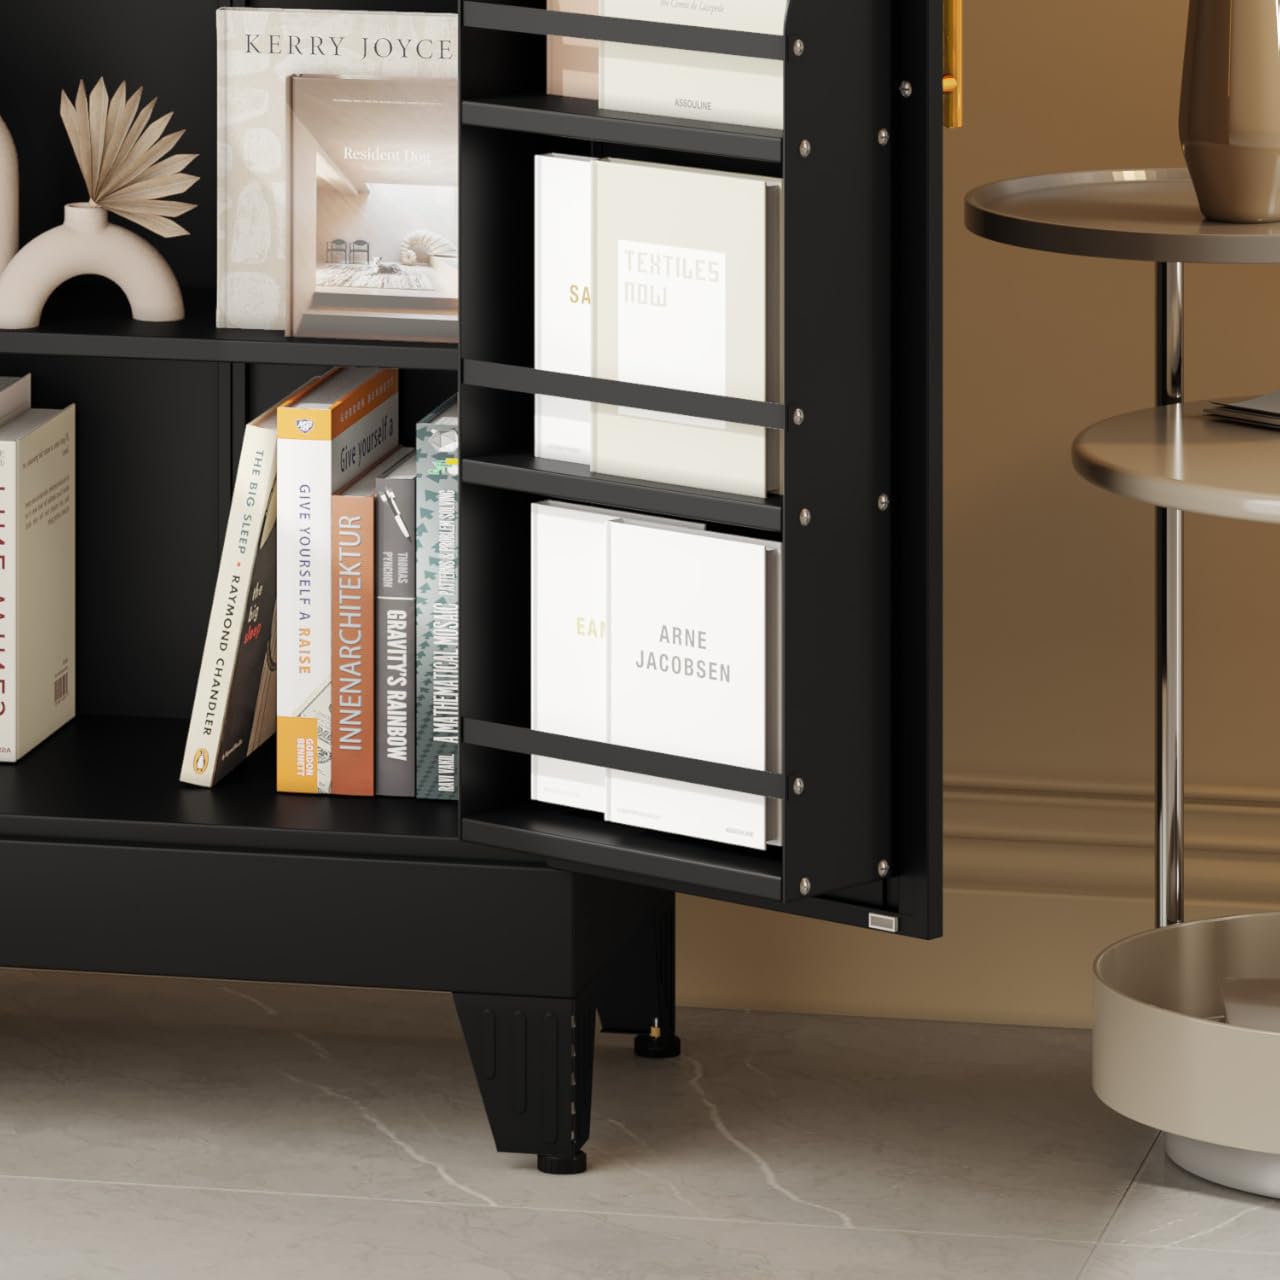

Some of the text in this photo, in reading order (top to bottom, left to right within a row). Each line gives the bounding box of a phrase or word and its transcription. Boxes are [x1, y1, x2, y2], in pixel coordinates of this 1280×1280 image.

[244, 33, 454, 62] KERRY JOYCE
[674, 97, 713, 111] ASSOULINE
[343, 146, 432, 166] Resident Dog
[623, 249, 720, 284] TEXTILES
[569, 284, 591, 305] SA
[340, 415, 394, 473] Give yourself a
[237, 449, 265, 556] THE BIG SLEEP
[298, 483, 311, 676] GIVE YOURSELF A RAISE
[382, 551, 394, 588] PYNCHON
[397, 552, 409, 585] THOMAS
[438, 560, 455, 597] PATTERNS
[338, 514, 362, 752] INNENARCHITEKTUR
[432, 602, 459, 646] MOSAIC
[658, 624, 708, 651] ARNE
[202, 575, 240, 737] RAYMOND CHANDLER
[635, 649, 732, 684] JACOBSEN
[386, 609, 408, 761] GRAVITY'S RAINBOW
[432, 647, 459, 733] MATHEMATICAL
[432, 735, 459, 744] A
[438, 754, 455, 774] VAKIL
[438, 774, 455, 792] RAVI
